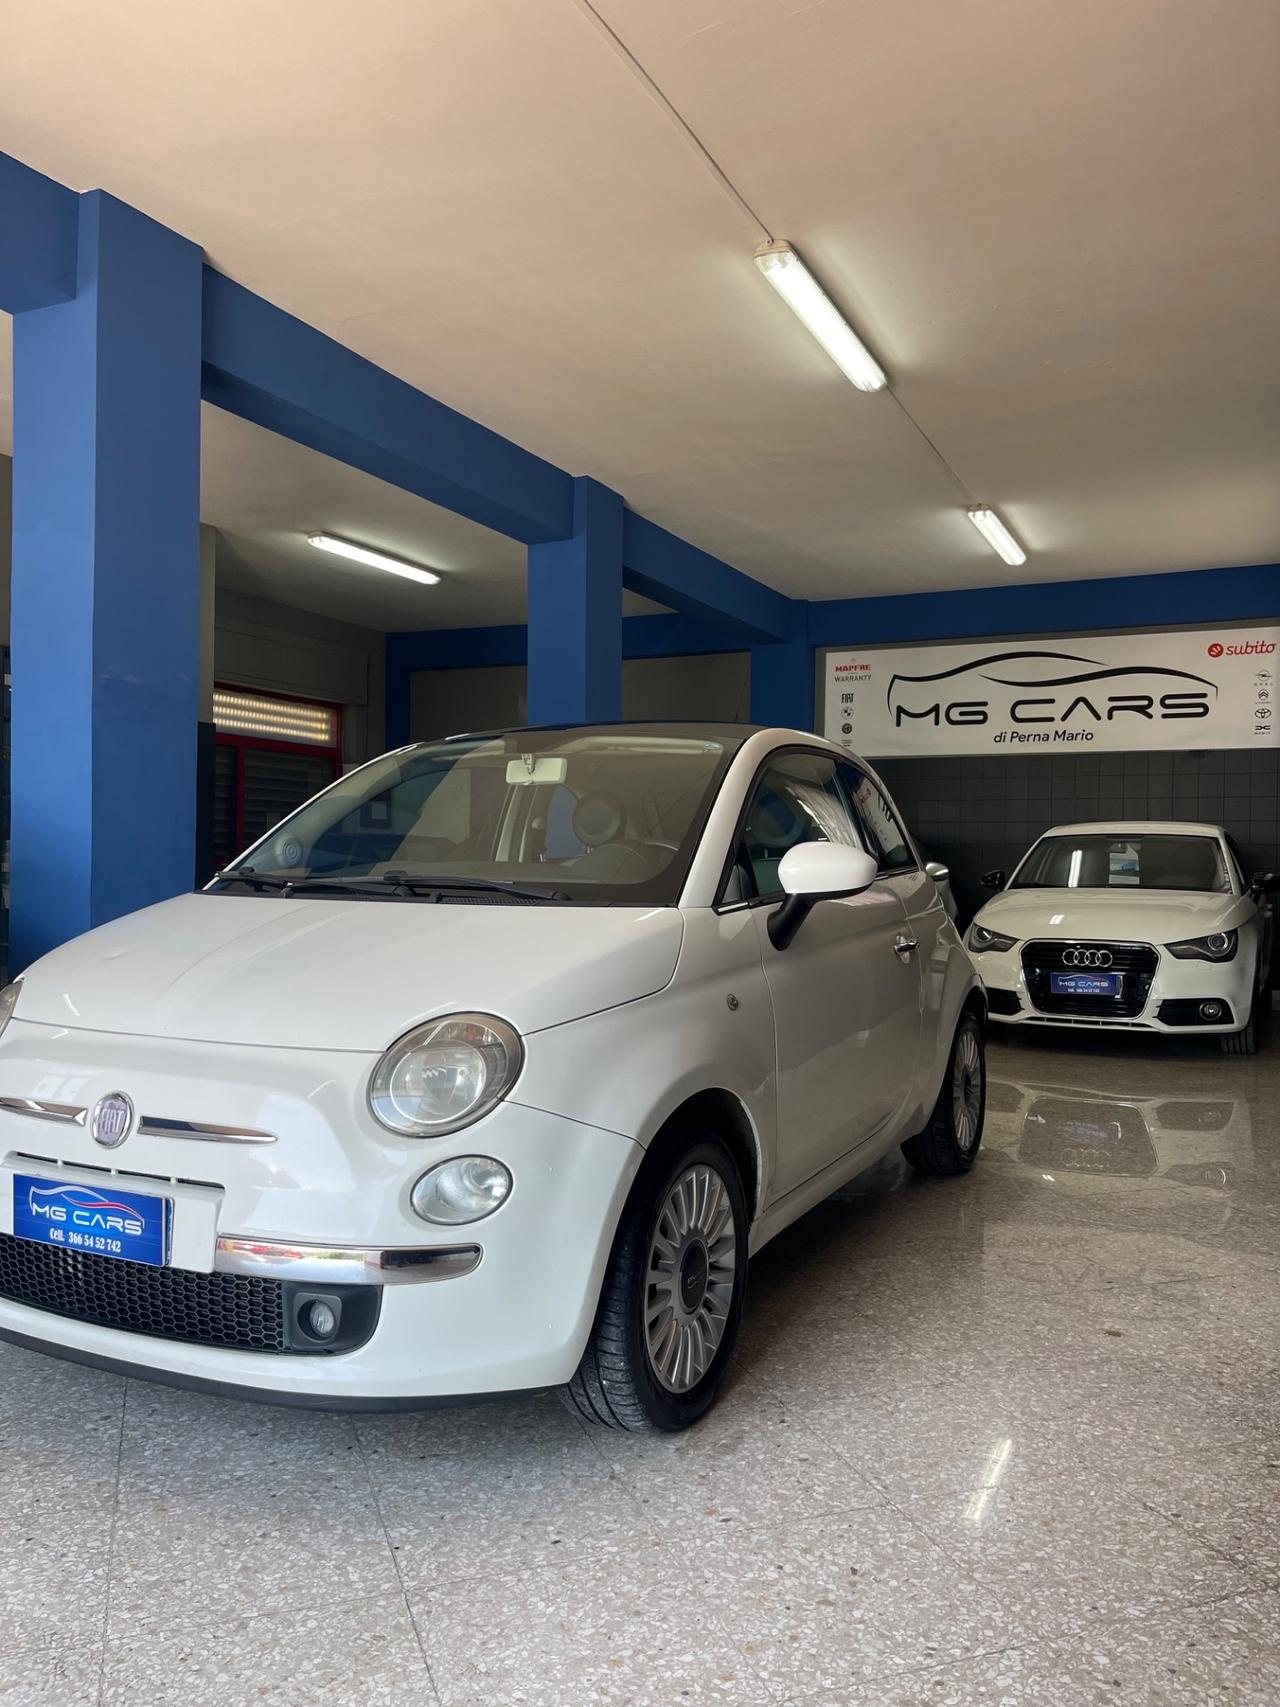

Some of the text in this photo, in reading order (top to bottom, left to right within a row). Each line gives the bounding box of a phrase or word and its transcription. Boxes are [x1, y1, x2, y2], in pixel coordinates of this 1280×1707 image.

[1225, 641, 1276, 656] subito
[835, 664, 871, 672] MAPFRE
[834, 674, 871, 682] WARRANTY
[841, 693, 854, 703] FIAT
[896, 693, 1209, 727] MG CARS
[993, 729, 1094, 743] di Perna Mario
[102, 1109, 125, 1133] FIAT
[32, 1203, 142, 1236] MG CARS
[50, 1228, 121, 1252] Cell. 366 54 52 742
